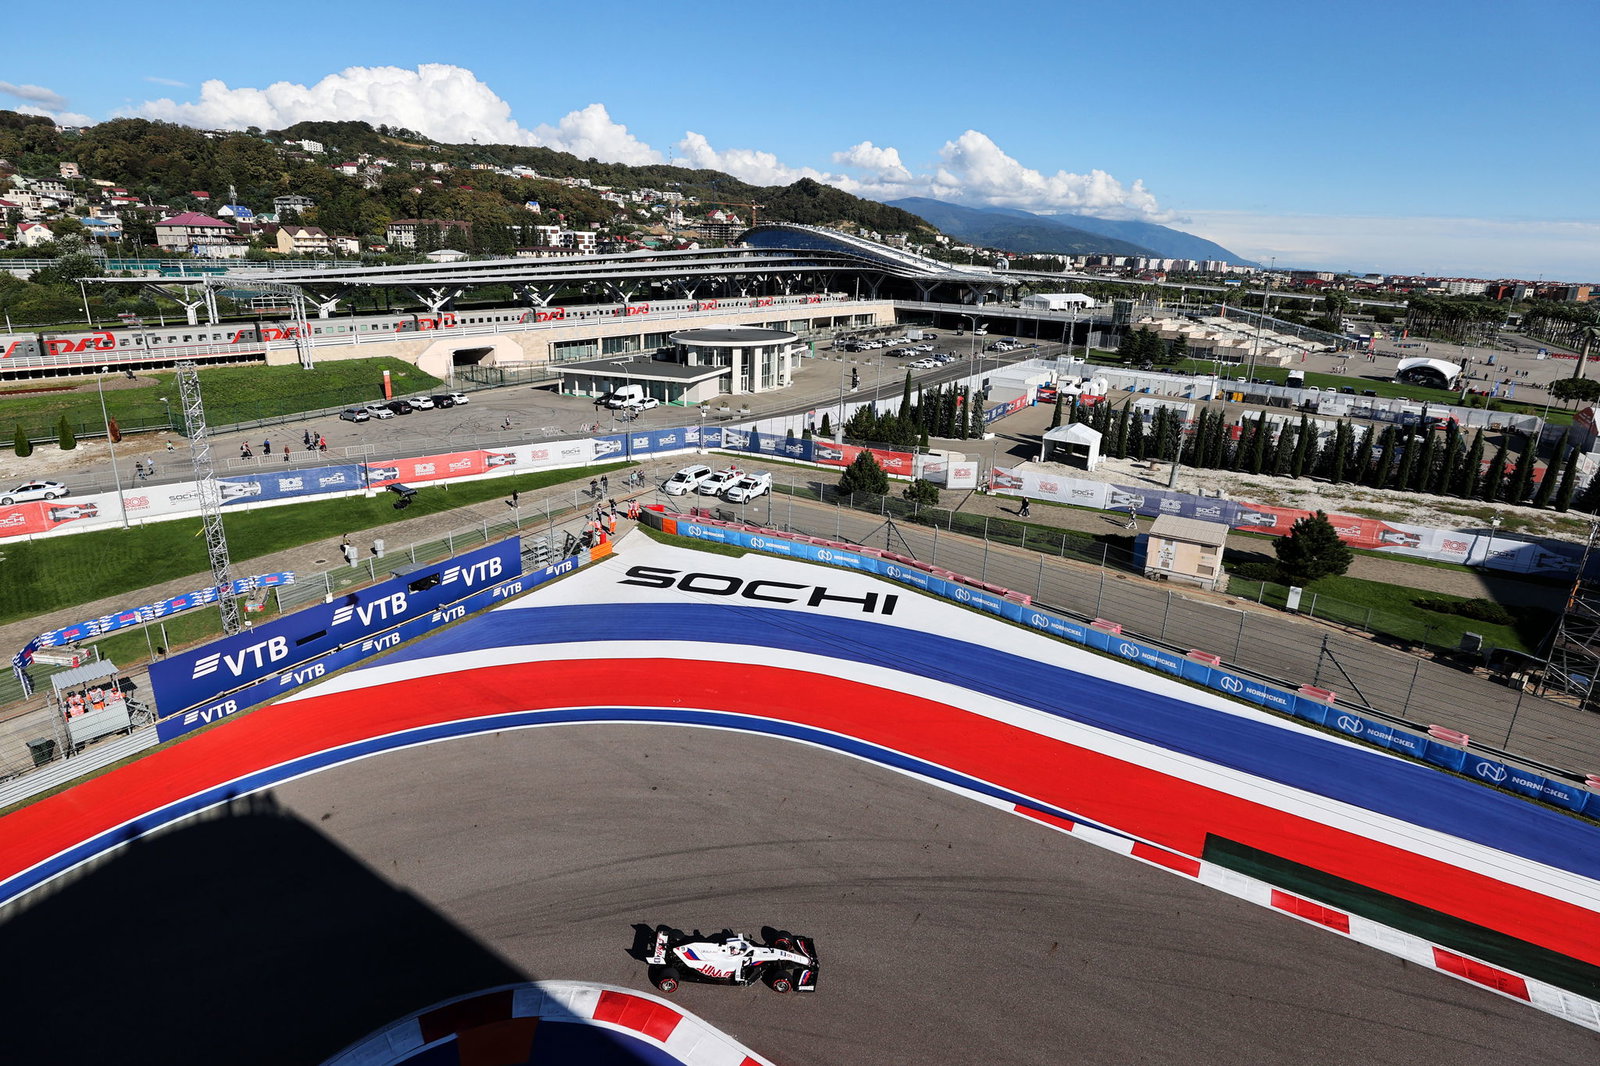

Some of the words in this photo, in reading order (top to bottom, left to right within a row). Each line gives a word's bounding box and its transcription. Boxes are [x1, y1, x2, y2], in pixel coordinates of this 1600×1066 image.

[461, 556, 503, 587] VTB
[553, 560, 573, 576] VTB
[902, 573, 927, 584] NORNICKEL
[501, 581, 523, 598] VTB
[616, 565, 899, 615] SOCHI
[356, 591, 408, 626] VTB
[972, 596, 1000, 609] NORNICKEL
[442, 605, 466, 623] VTB
[1051, 622, 1082, 637] NORNICKEL
[373, 632, 401, 652] VTB
[223, 635, 289, 677] VTB
[1142, 652, 1177, 669] NORNICKEL
[293, 663, 326, 684] VTB
[1246, 687, 1287, 705] NORNICKEL
[200, 699, 238, 724] VTB
[1367, 728, 1415, 749] NORNICKEL
[1511, 776, 1570, 800] NORNICKEL
[697, 964, 736, 978] HAAS
